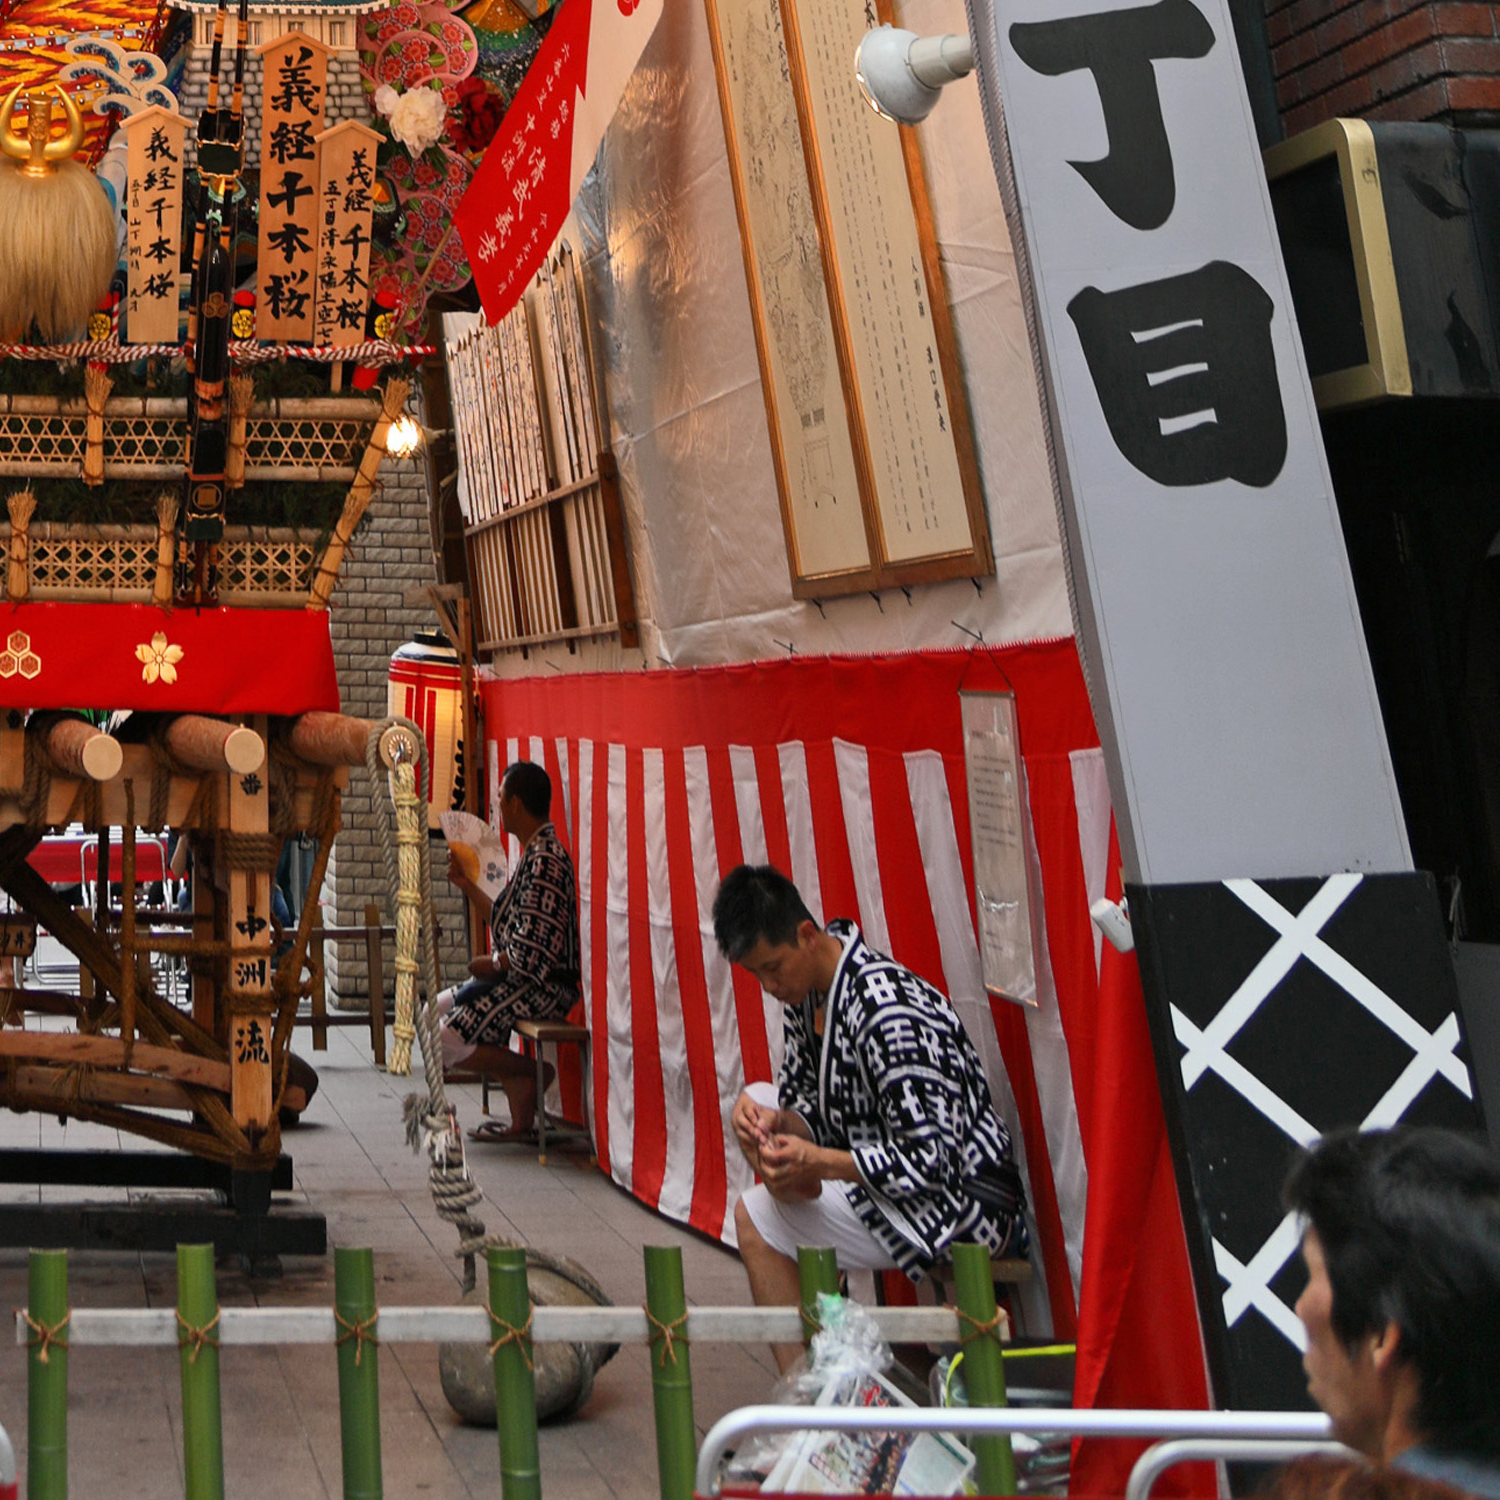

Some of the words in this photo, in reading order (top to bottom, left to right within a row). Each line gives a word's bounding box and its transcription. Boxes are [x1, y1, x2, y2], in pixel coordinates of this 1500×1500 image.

[141, 126, 178, 299] 義経千本桜
[264, 46, 322, 320] 義経千本桜
[336, 149, 373, 330] 義経千本桜
[235, 906, 269, 1064] 中洲流
